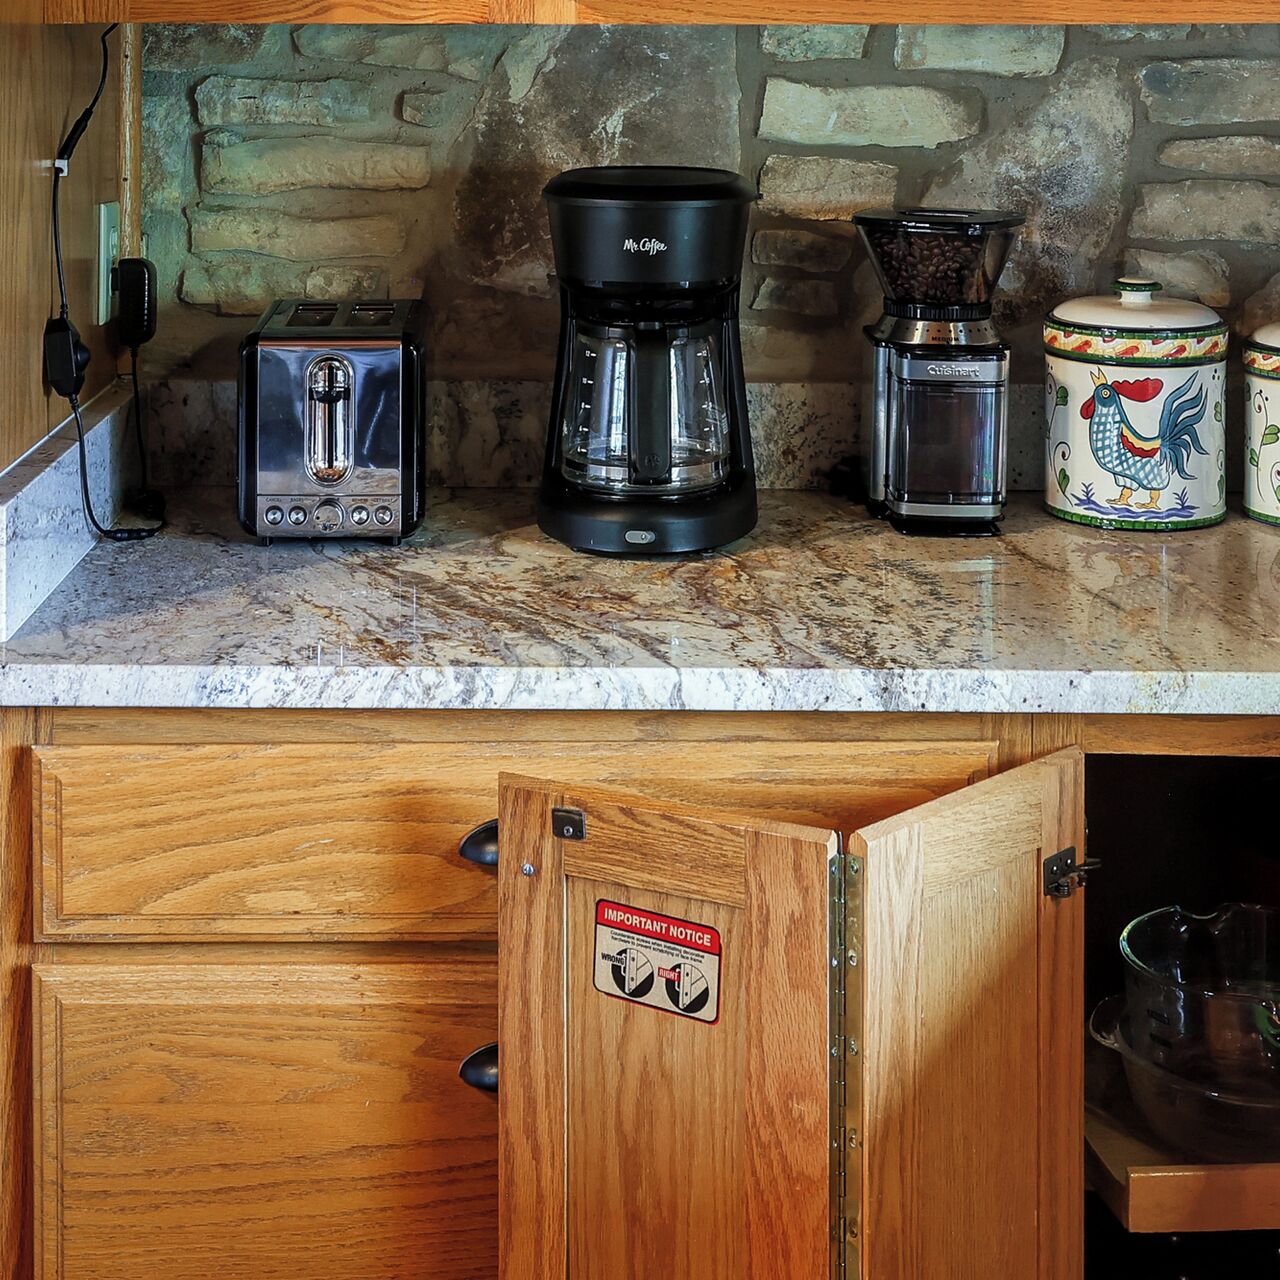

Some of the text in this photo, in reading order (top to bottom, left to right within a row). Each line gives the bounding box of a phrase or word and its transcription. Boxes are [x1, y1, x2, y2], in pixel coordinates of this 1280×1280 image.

[623, 237, 668, 256] Mr. Coffee
[927, 365, 980, 377] Cuisinart
[604, 907, 712, 947] IMPORTANT NOTICE
[601, 952, 625, 966] WRONG
[659, 968, 680, 982] RIGHT
